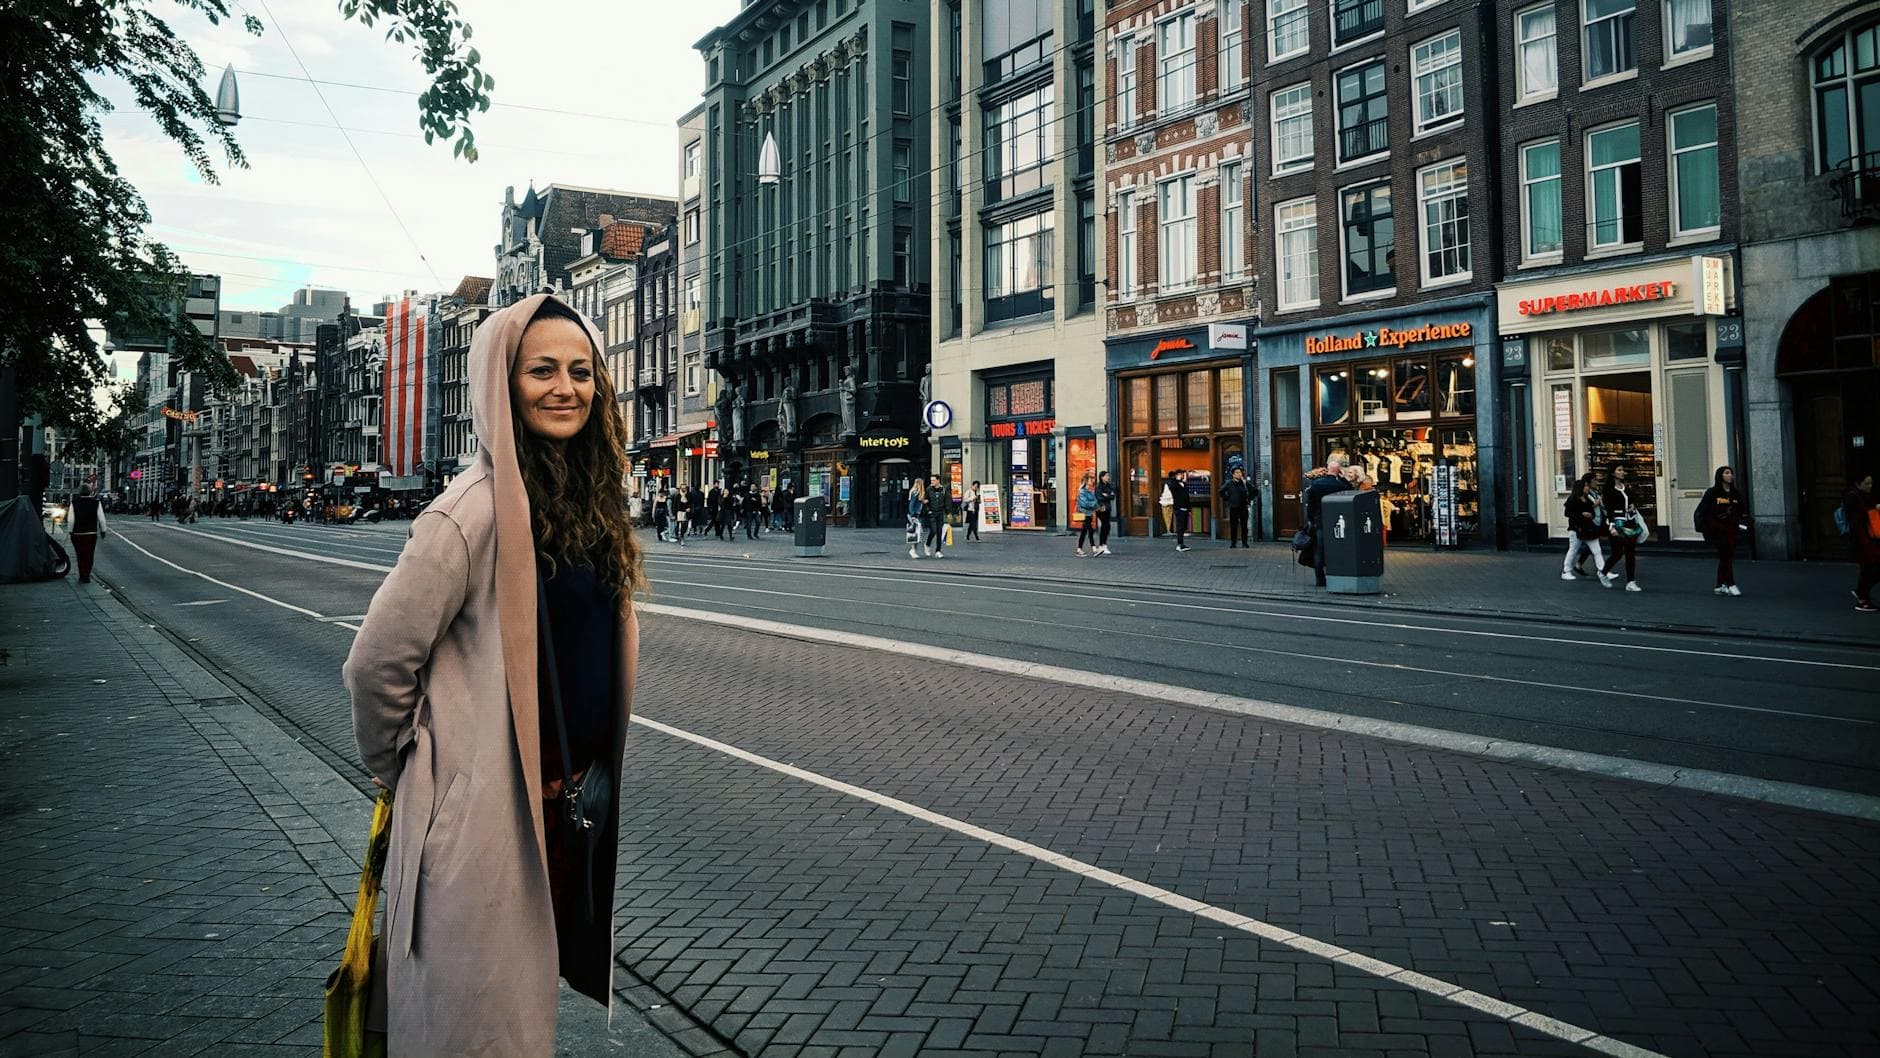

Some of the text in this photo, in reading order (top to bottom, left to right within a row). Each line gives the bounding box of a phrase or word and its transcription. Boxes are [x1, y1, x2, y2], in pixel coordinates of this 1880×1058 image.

[1519, 281, 1674, 316] SUPERMARKET
[1705, 260, 1713, 313] SUPER
[1713, 260, 1721, 314] MARKT
[1305, 321, 1470, 354] Holland Experience
[1718, 324, 1740, 341] 23
[1505, 344, 1522, 361] 23
[859, 436, 909, 448] Intertoys
[991, 423, 1016, 437] TOURS
[1017, 422, 1025, 436] &
